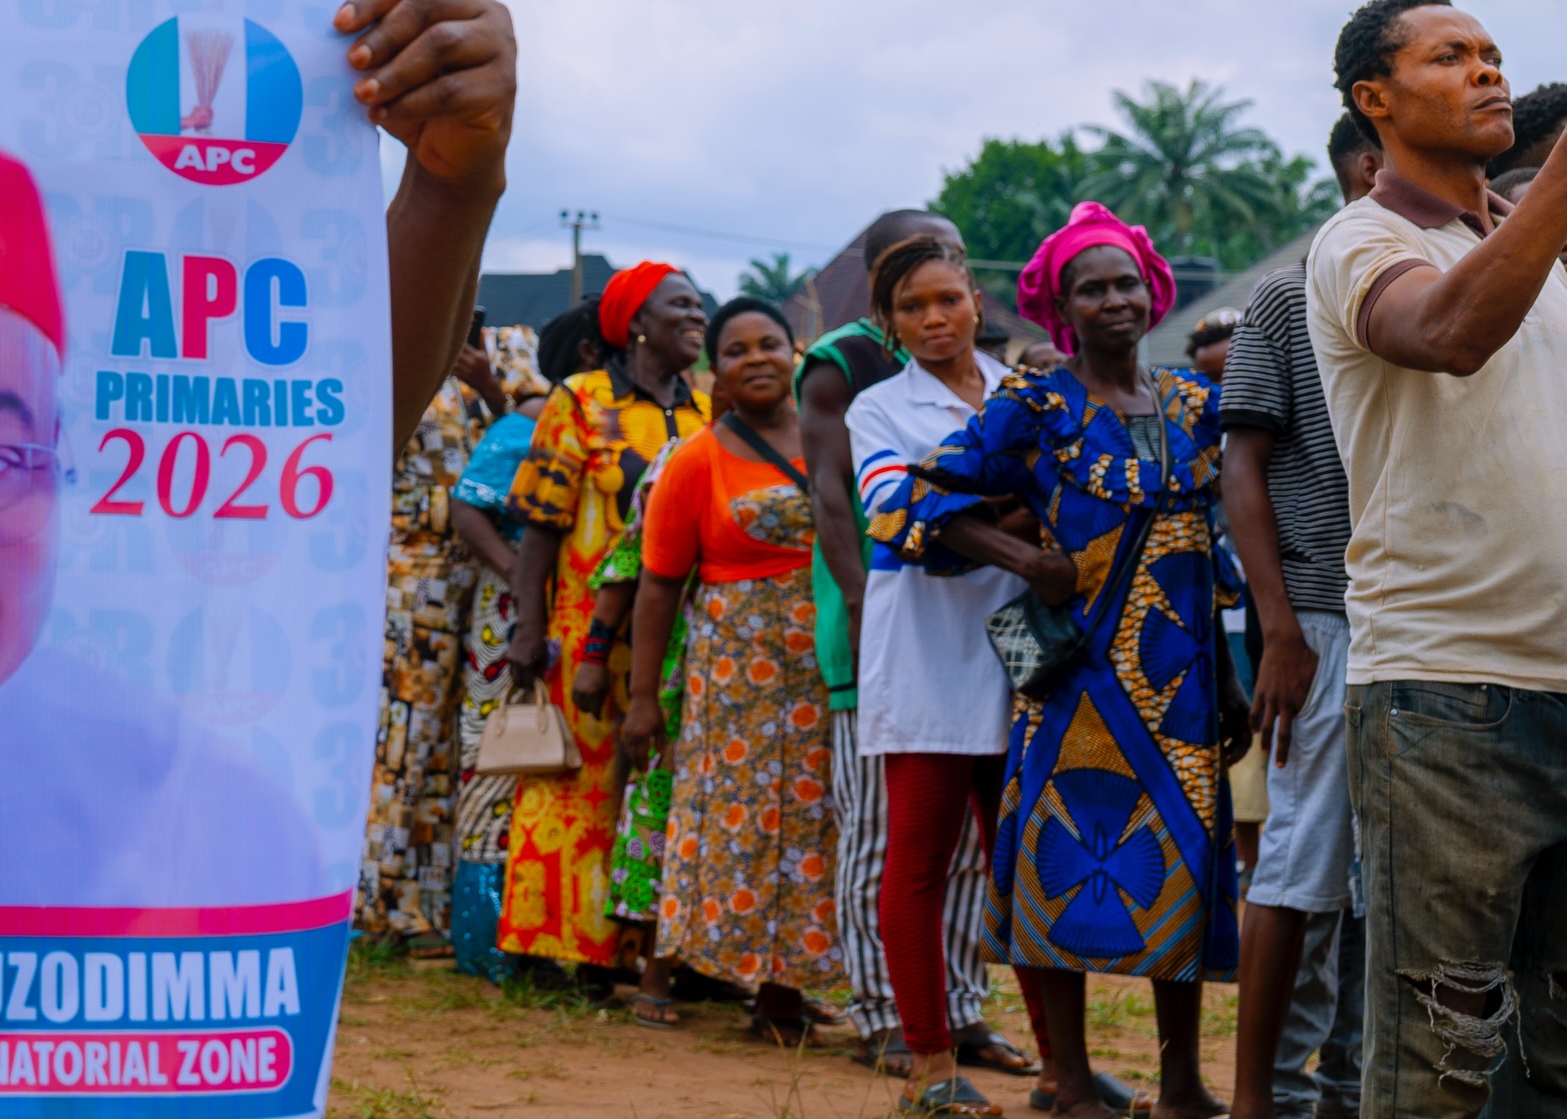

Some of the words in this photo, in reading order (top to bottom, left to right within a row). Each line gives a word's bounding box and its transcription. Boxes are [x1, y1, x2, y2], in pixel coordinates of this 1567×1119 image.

[175, 145, 255, 174] APC
[110, 249, 309, 367] APC
[95, 370, 346, 428] PRIMARIES
[89, 427, 334, 519] 2026
[203, 698, 259, 716] APC
[177, 1037, 277, 1085] ZONE
